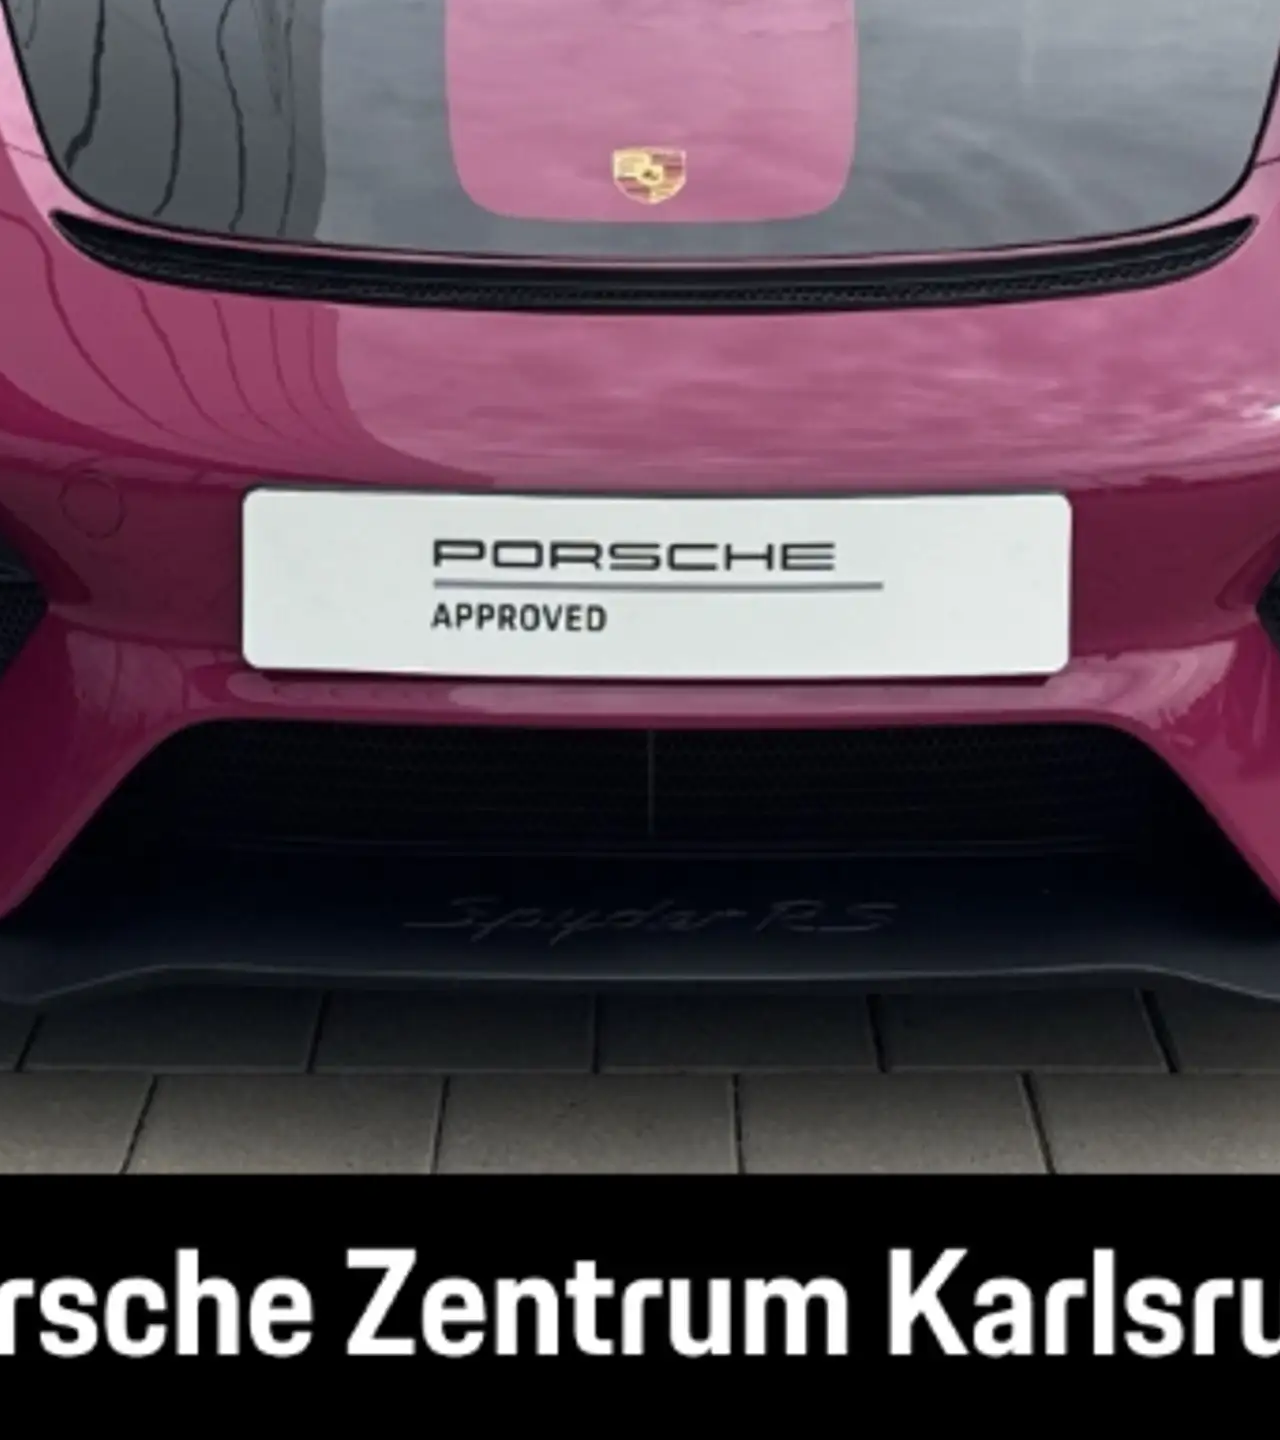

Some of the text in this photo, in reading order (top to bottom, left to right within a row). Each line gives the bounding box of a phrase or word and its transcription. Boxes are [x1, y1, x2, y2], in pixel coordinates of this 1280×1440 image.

[432, 538, 836, 572] PORSCHE
[431, 603, 608, 632] APPROVED
[402, 896, 898, 946] Spyder RS
